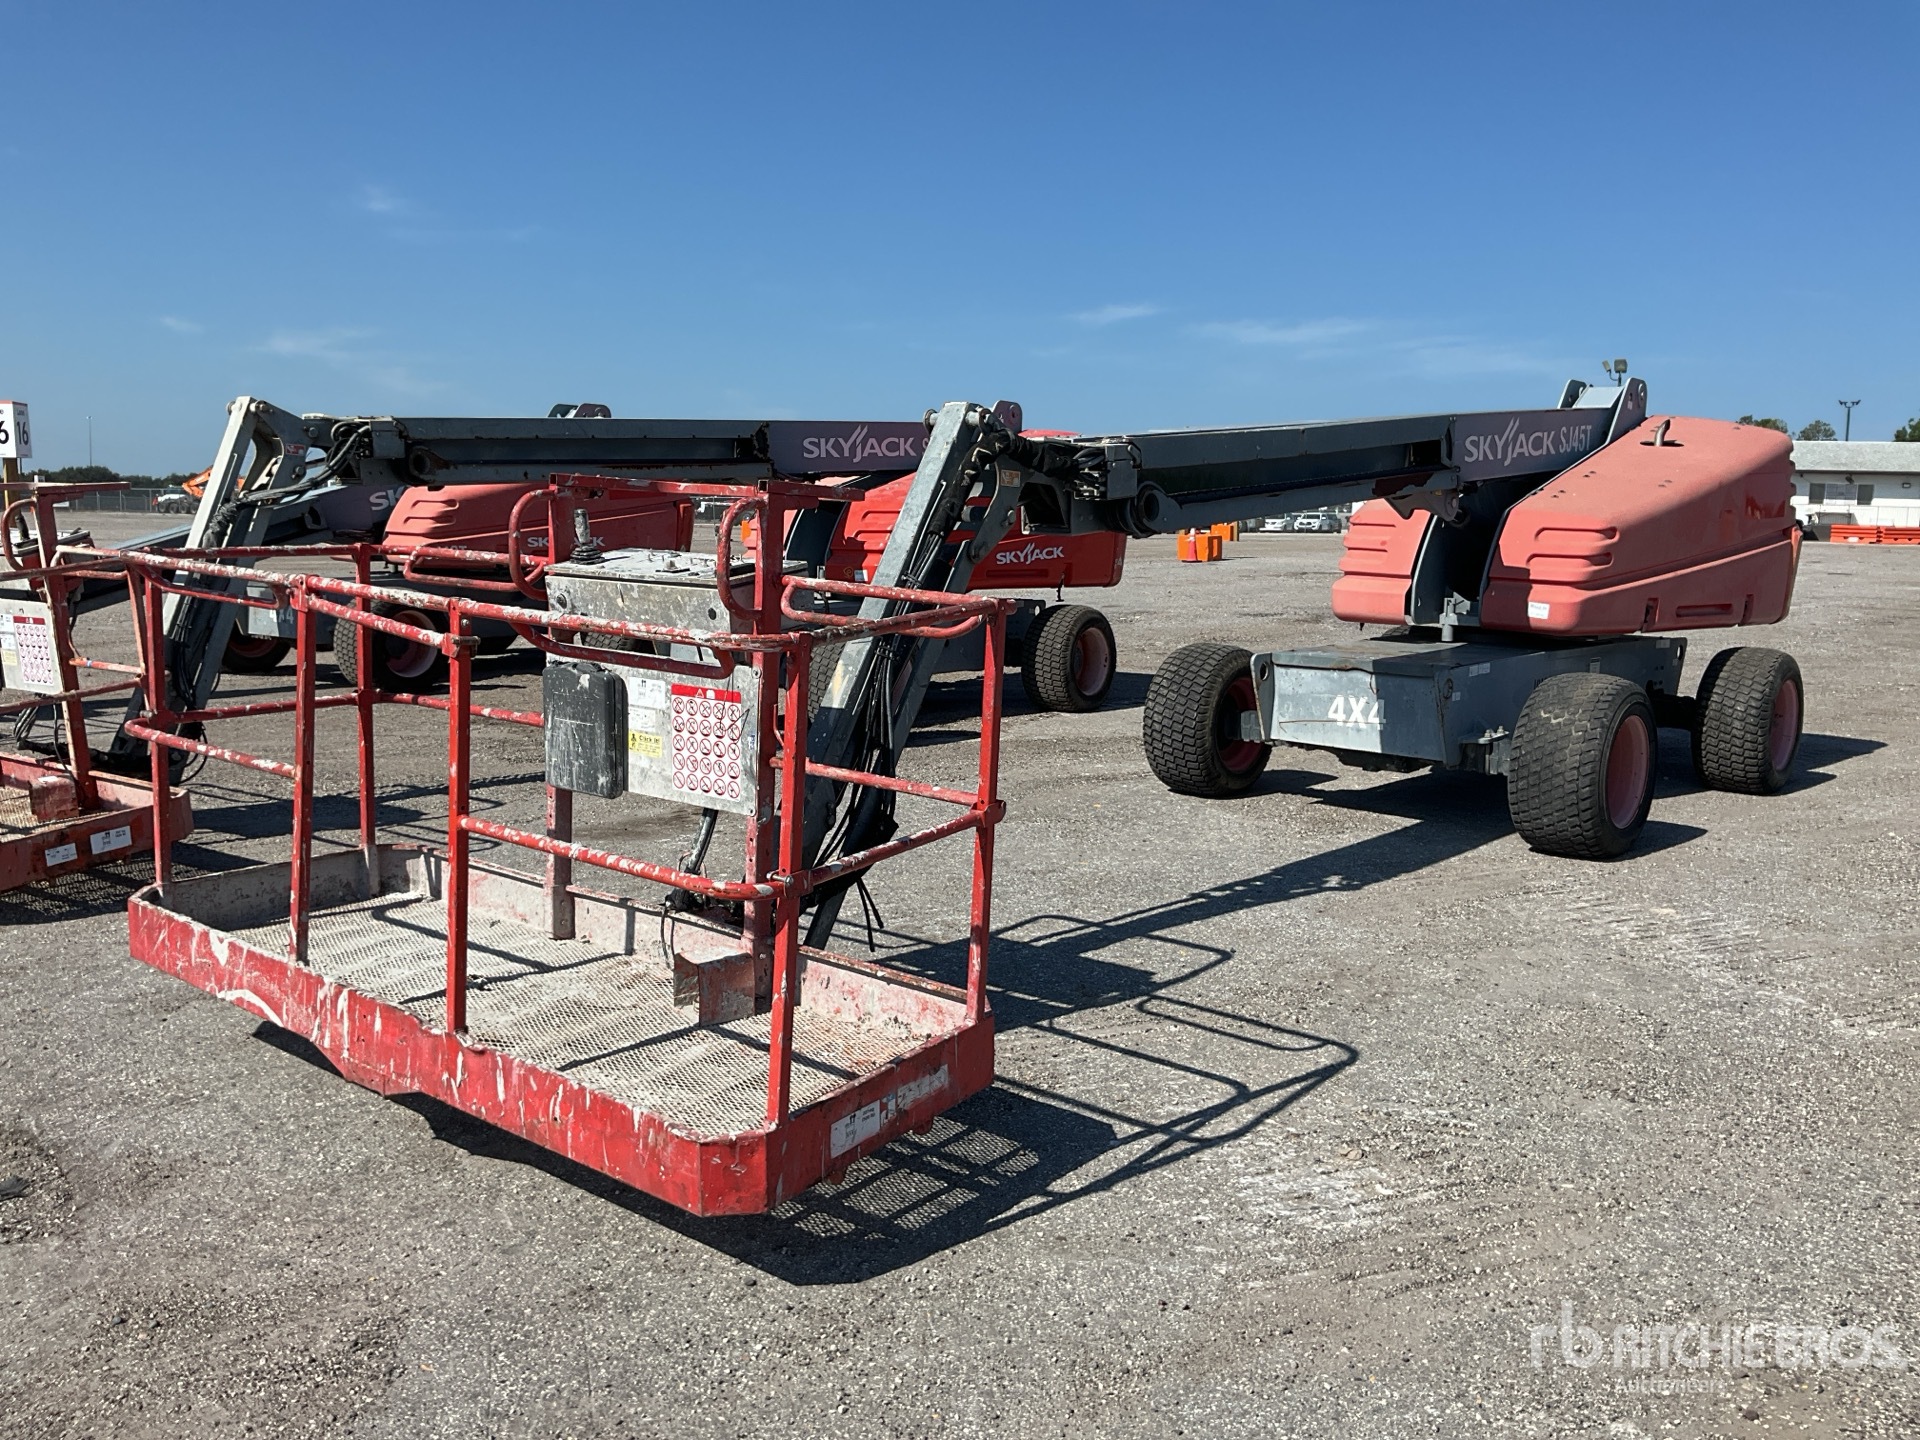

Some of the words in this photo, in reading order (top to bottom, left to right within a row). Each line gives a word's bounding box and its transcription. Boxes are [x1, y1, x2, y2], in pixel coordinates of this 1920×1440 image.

[17, 421, 29, 446] 16
[803, 425, 917, 462] SKYJACK
[1464, 416, 1555, 467] SKYJACK
[1559, 425, 1592, 453] SJ45T
[996, 542, 1064, 565] SKYJACK
[1327, 694, 1387, 731] 4X4
